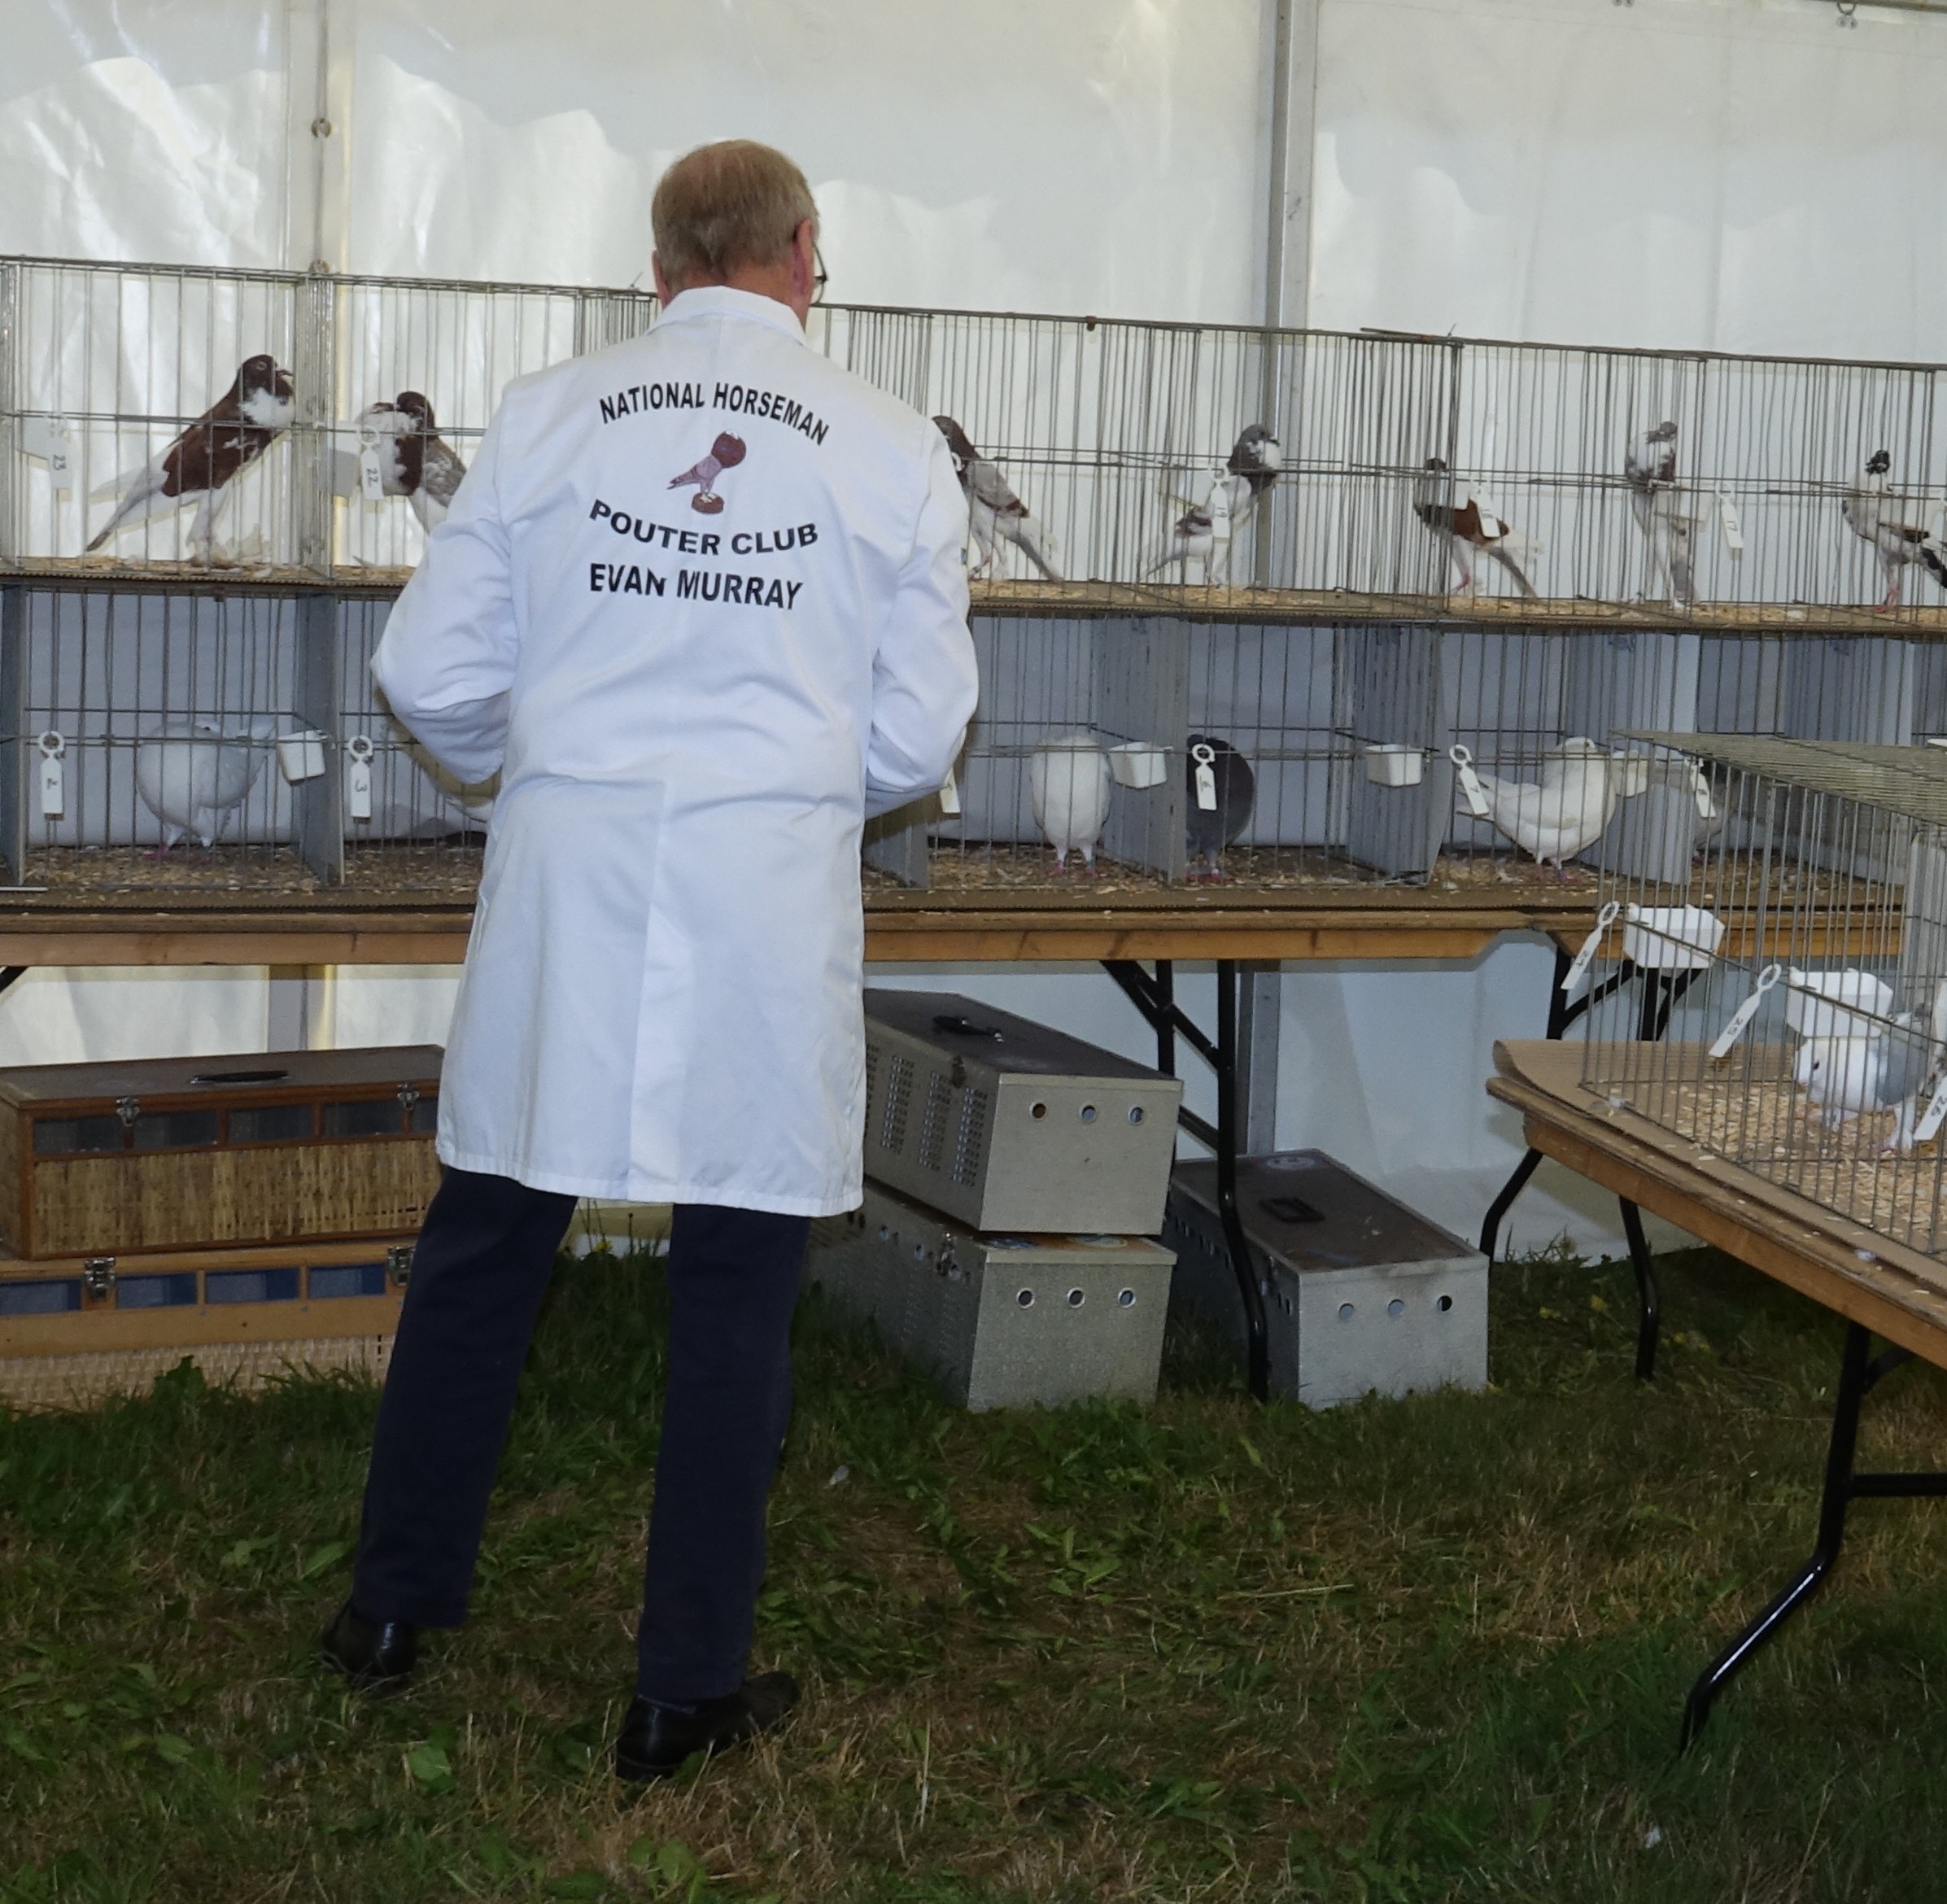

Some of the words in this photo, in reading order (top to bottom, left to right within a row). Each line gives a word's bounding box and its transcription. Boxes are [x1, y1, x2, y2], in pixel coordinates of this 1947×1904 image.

[599, 382, 705, 424] NATIONAL
[713, 382, 829, 446] HORSEMAN
[52, 453, 67, 470] 23
[366, 468, 378, 487] 22
[588, 499, 721, 556] POUTER
[731, 523, 819, 555] CLUB
[589, 562, 667, 597] EVAN
[676, 569, 804, 610] MURRAY
